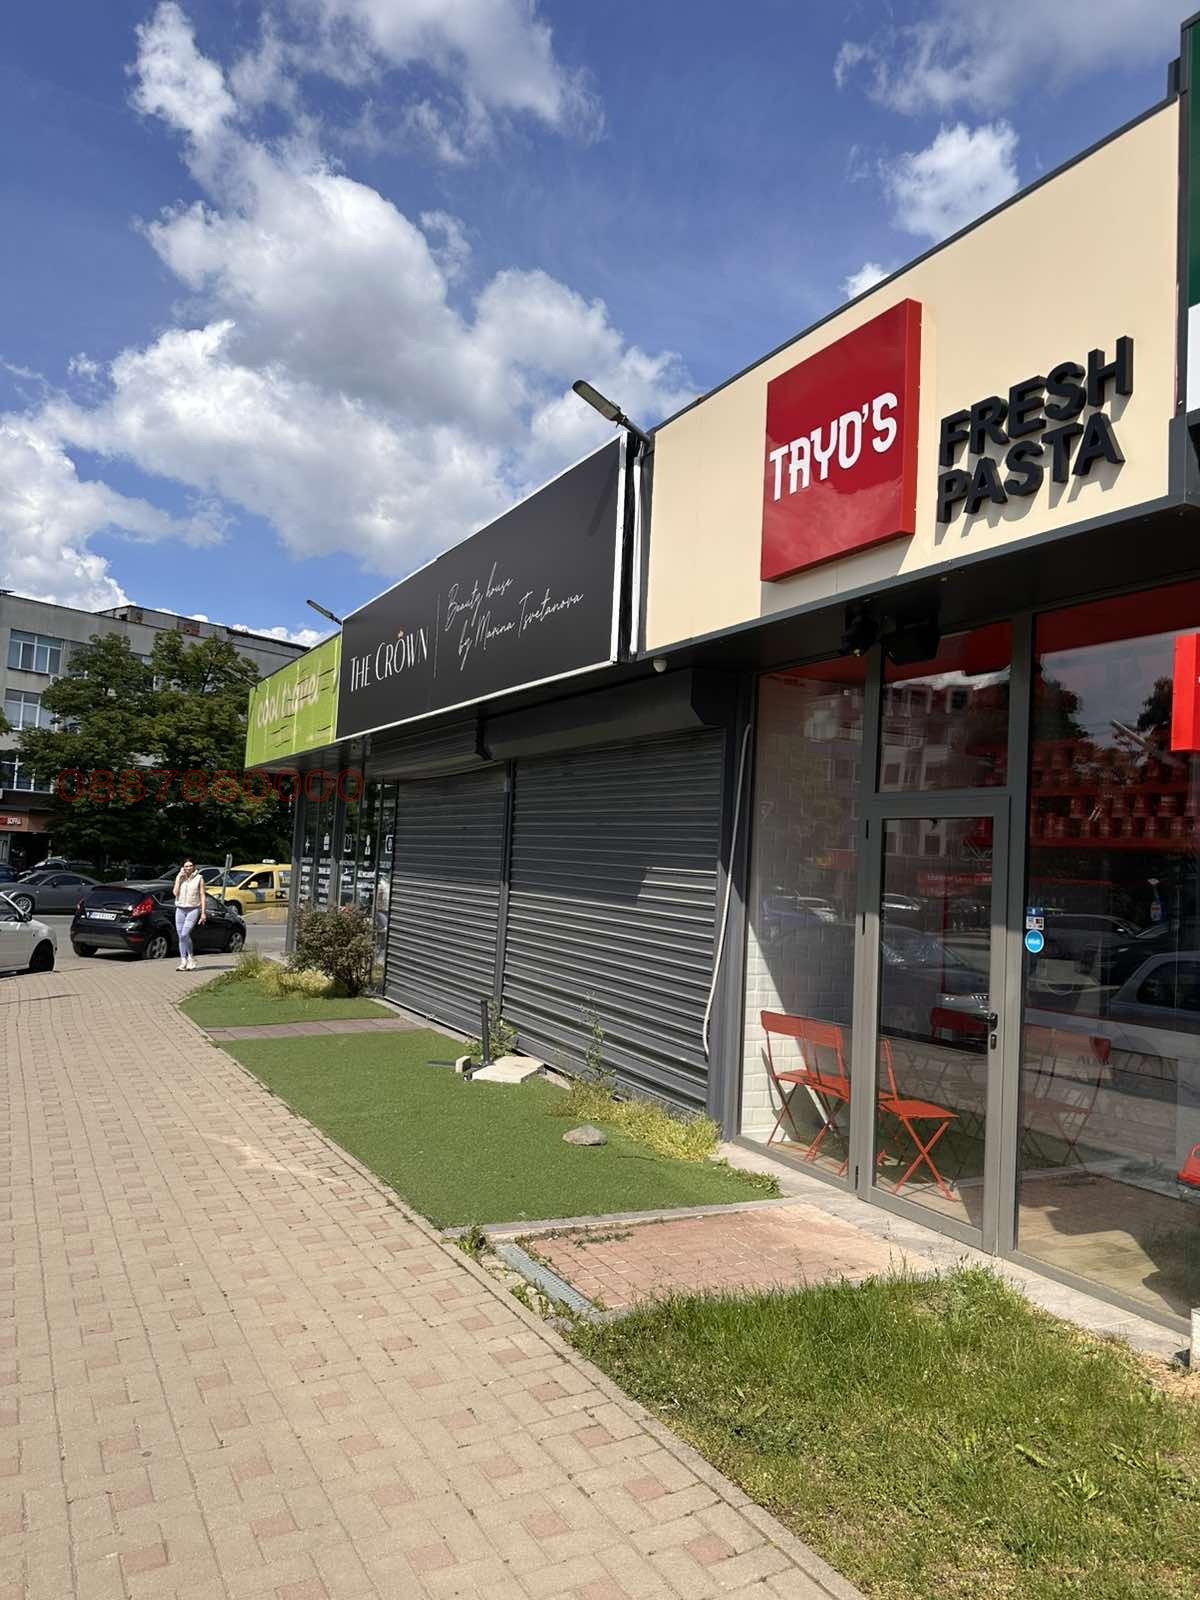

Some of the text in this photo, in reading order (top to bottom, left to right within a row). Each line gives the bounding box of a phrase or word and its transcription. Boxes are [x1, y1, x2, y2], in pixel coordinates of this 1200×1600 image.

[768, 391, 898, 501] TAYO'S
[938, 335, 1134, 468] FRESH
[936, 411, 1126, 524] PASTA
[445, 561, 514, 632] Beauty house
[350, 627, 429, 693] THE CROWN
[458, 619, 473, 671] by
